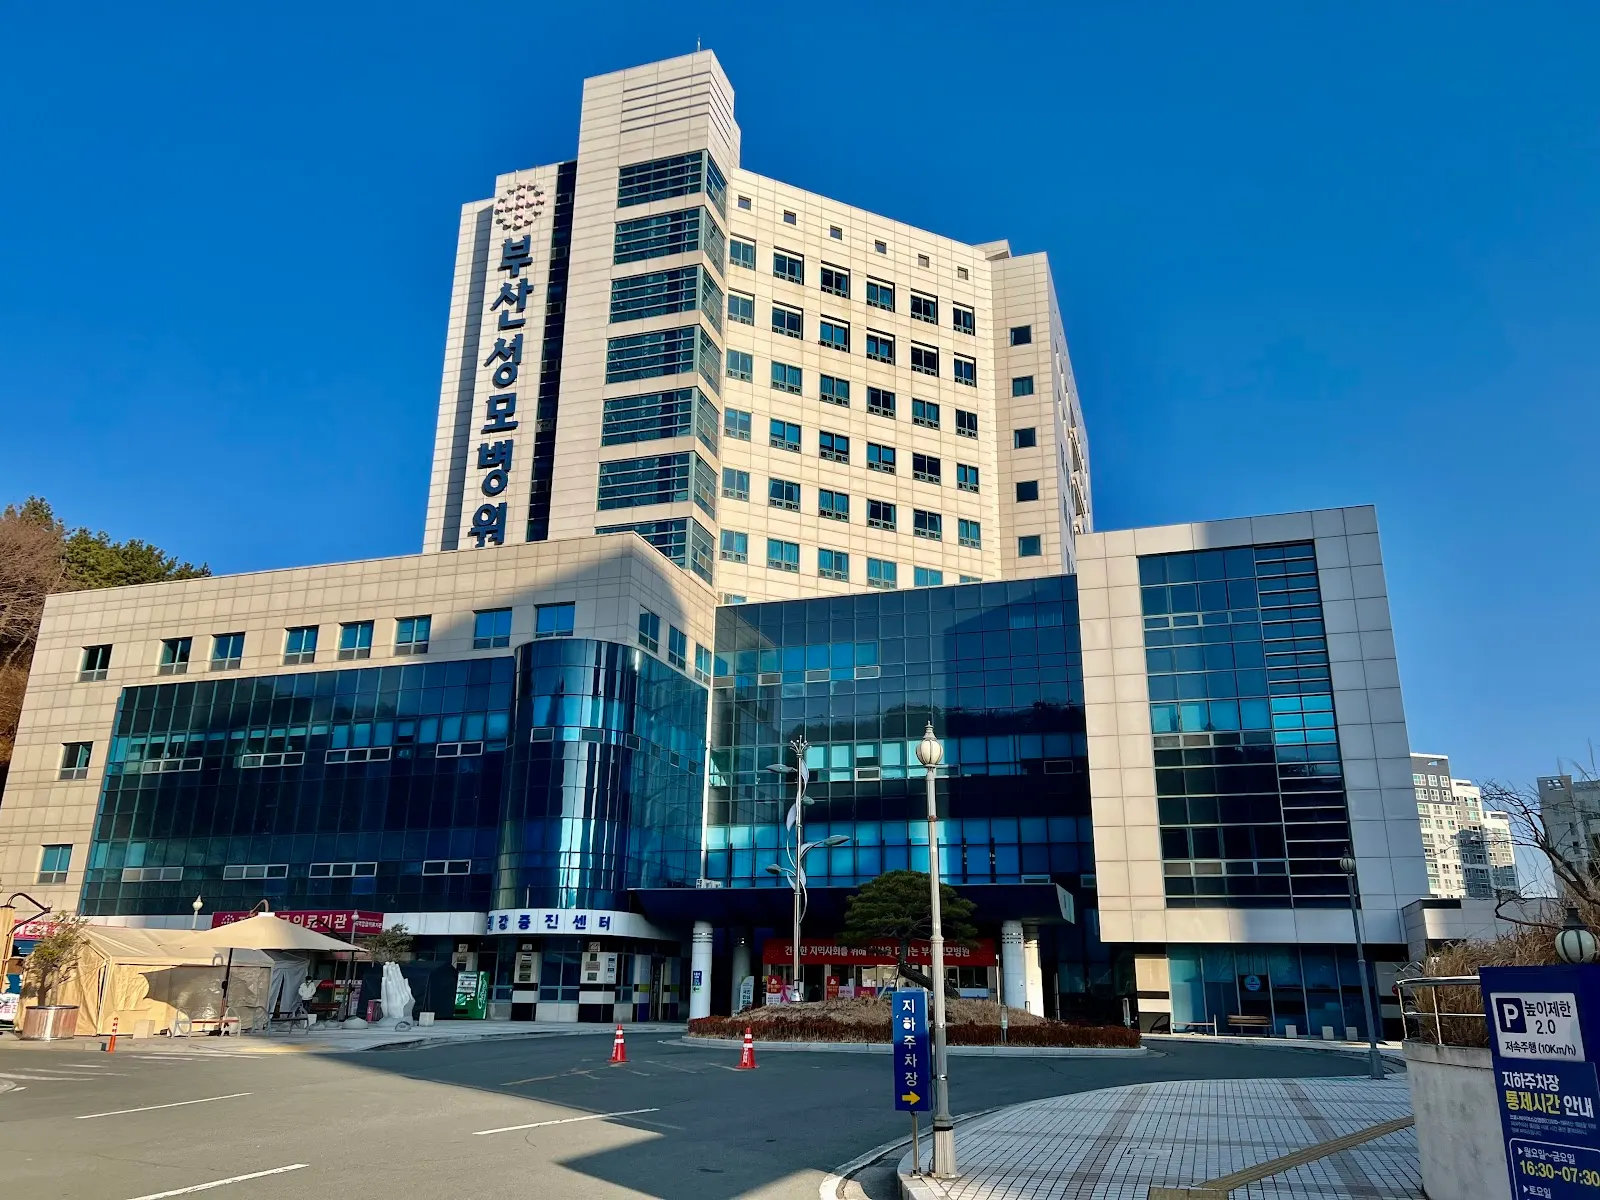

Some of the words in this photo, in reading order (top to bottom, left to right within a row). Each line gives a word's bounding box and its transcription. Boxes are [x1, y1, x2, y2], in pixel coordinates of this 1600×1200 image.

[467, 235, 534, 548] 부산성모병원
[785, 946, 808, 956] 건한
[809, 946, 848, 957] 지역사회를
[921, 945, 971, 958] 부모병원
[1503, 1003, 1519, 1028] P
[1524, 1000, 1572, 1018] 높이제한
[1535, 1019, 1556, 1035] 2.0
[902, 998, 919, 1088] 지하주차장
[1505, 1040, 1537, 1054] 저속주행
[1538, 1042, 1577, 1057] (10Km/h)
[1501, 1071, 1560, 1092] 지하주차장
[1505, 1089, 1561, 1115] 통제시간
[1563, 1095, 1595, 1119] 안내
[1519, 1160, 1600, 1187] 16:30~07:30
[1528, 1185, 1553, 1199] 토요일
